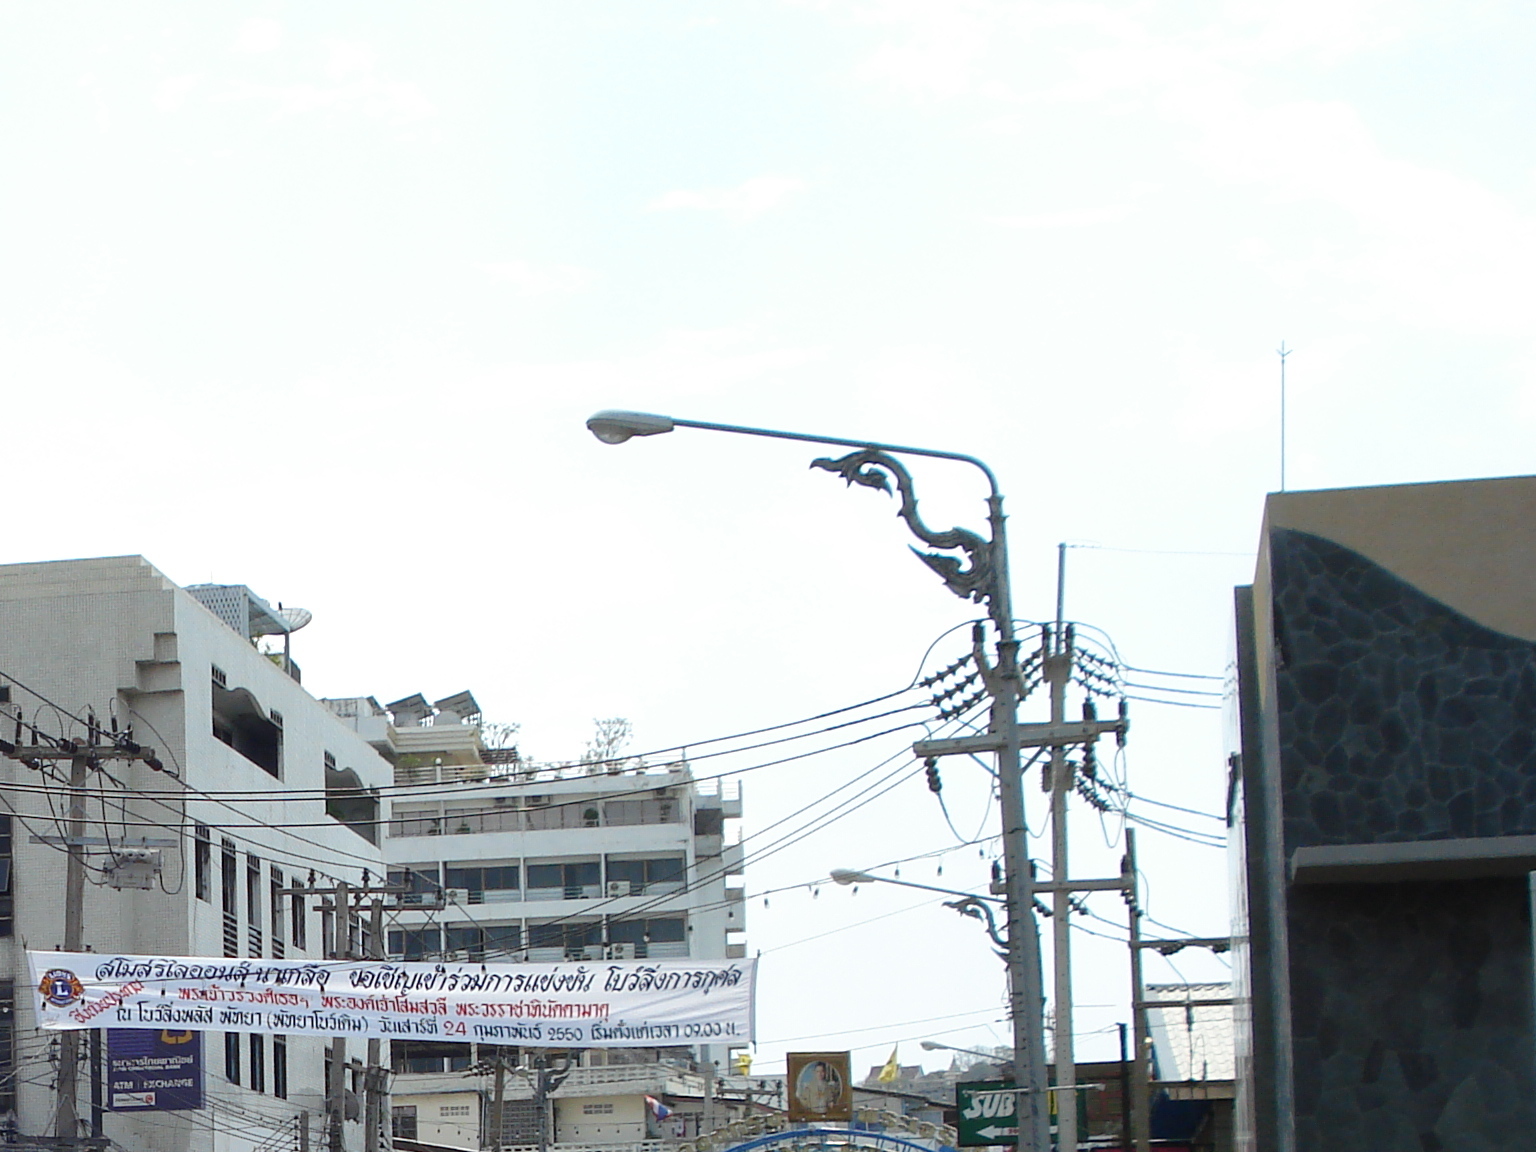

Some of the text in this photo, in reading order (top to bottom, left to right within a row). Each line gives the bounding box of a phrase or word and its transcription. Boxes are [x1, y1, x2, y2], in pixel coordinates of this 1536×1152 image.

[443, 1020, 467, 1036] 24
[547, 1027, 583, 1041] 2550
[683, 1022, 722, 1038] 09.00
[113, 1078, 193, 1090] ATM EXCHANGE
